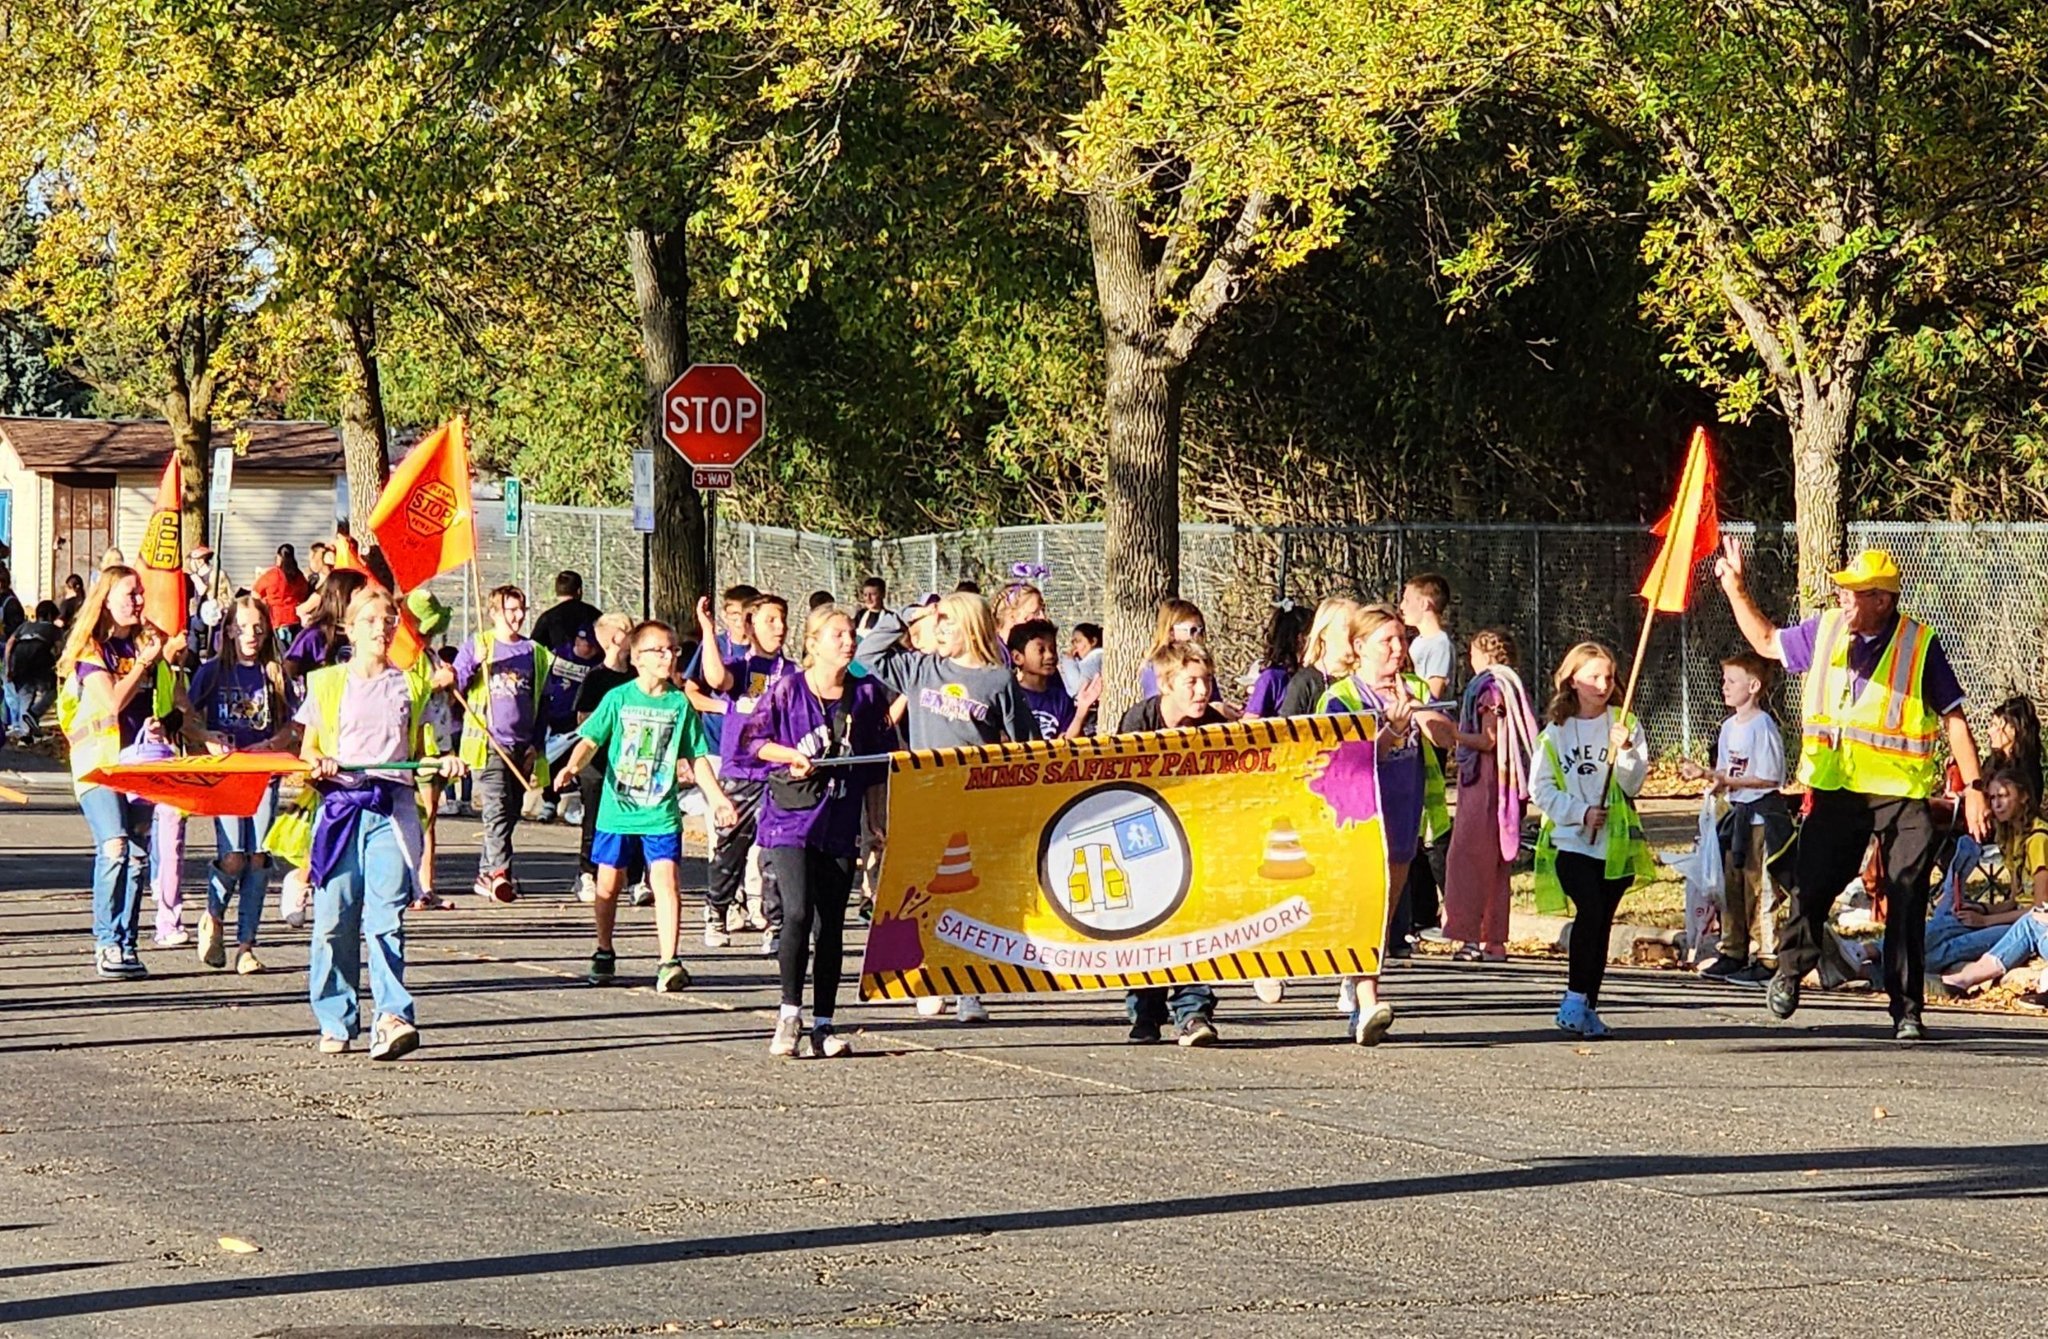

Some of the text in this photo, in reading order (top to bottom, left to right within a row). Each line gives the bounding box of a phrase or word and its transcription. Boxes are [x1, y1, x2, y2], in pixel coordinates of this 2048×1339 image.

[669, 396, 757, 434] STOP
[695, 473, 730, 486] 3-WAY
[411, 493, 452, 521] STOP
[155, 517, 179, 563] STOP
[964, 747, 1277, 791] MMS SAFETY PATROL
[937, 901, 1309, 968] SAFETY BEGINS WITH TEAMWORK
